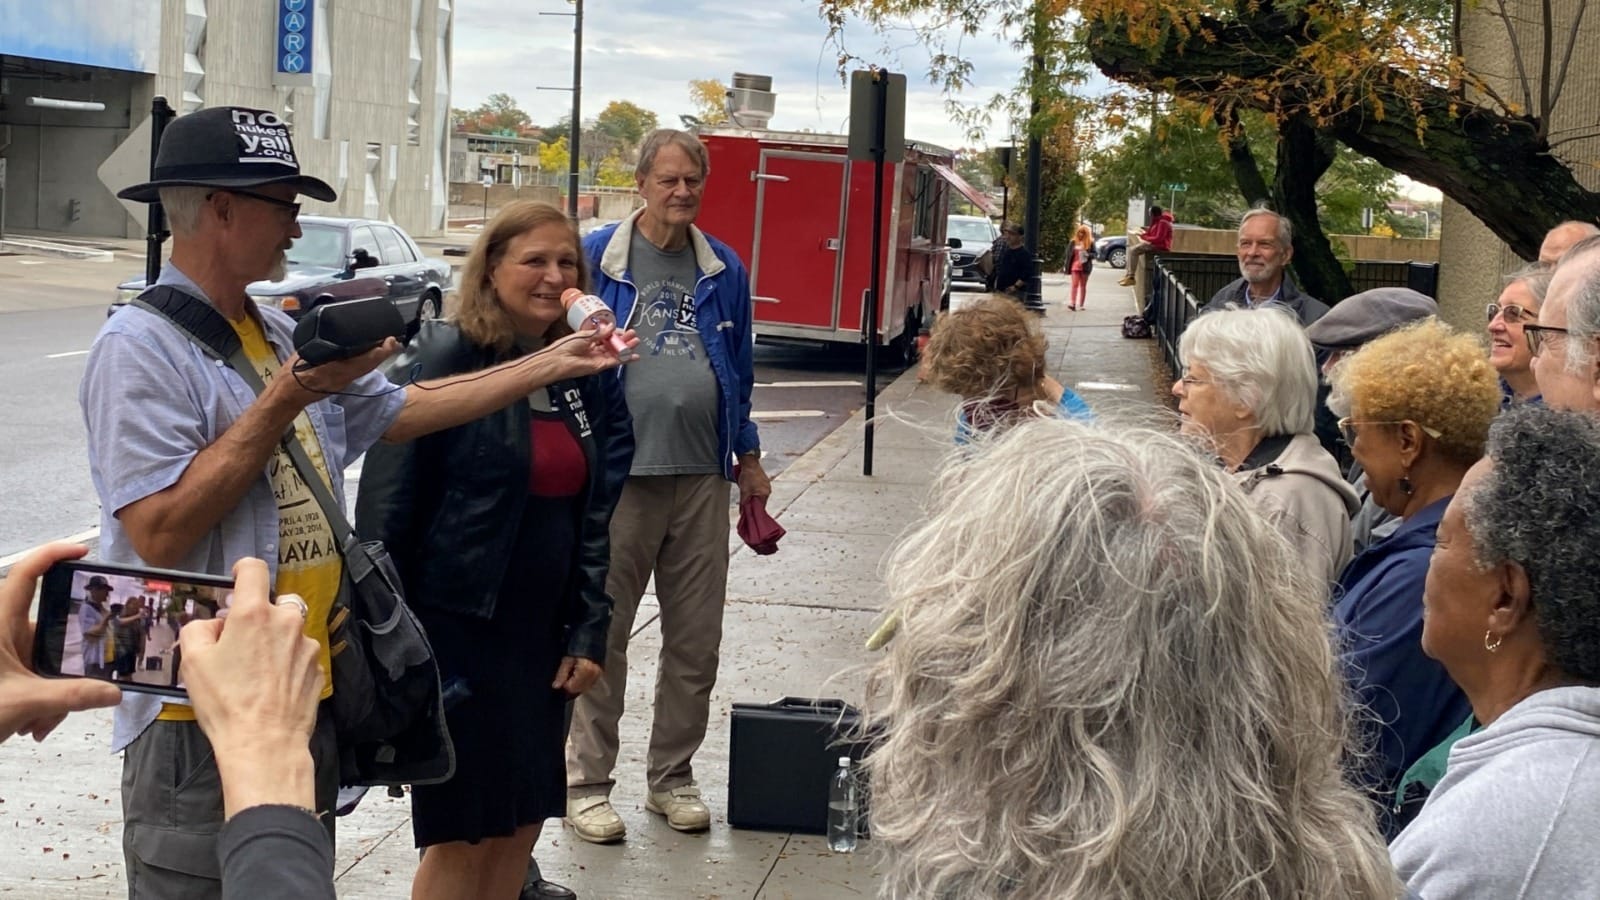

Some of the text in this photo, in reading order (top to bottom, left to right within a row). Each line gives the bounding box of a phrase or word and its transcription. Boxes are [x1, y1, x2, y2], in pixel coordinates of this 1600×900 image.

[287, 0, 301, 70] PARK
[231, 110, 284, 126] no
[235, 124, 287, 137] nukes
[240, 134, 290, 153] yall
[258, 149, 293, 162] .org
[660, 291, 677, 300] 2015
[633, 300, 680, 327] KANS
[278, 516, 296, 527] PRIL
